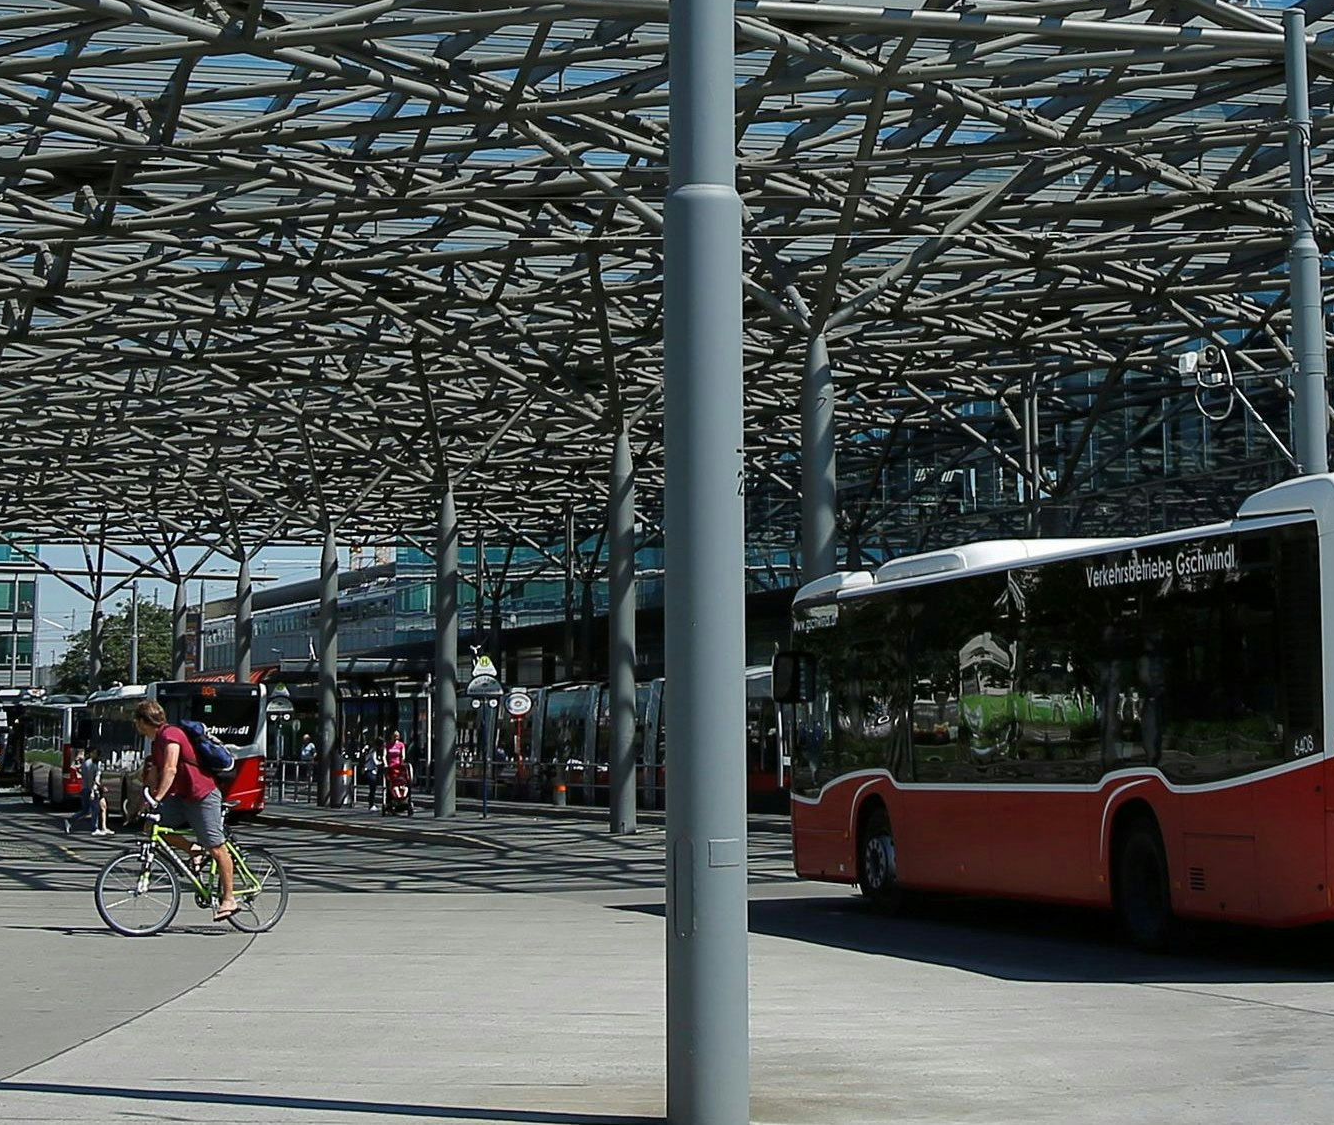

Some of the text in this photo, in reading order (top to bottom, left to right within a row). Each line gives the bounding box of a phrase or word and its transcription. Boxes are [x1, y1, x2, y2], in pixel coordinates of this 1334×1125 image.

[1085, 544, 1235, 588] Verkehrsbetriebe Gschwindl
[205, 725, 250, 735] chwindl
[1294, 734, 1314, 756] 6408
